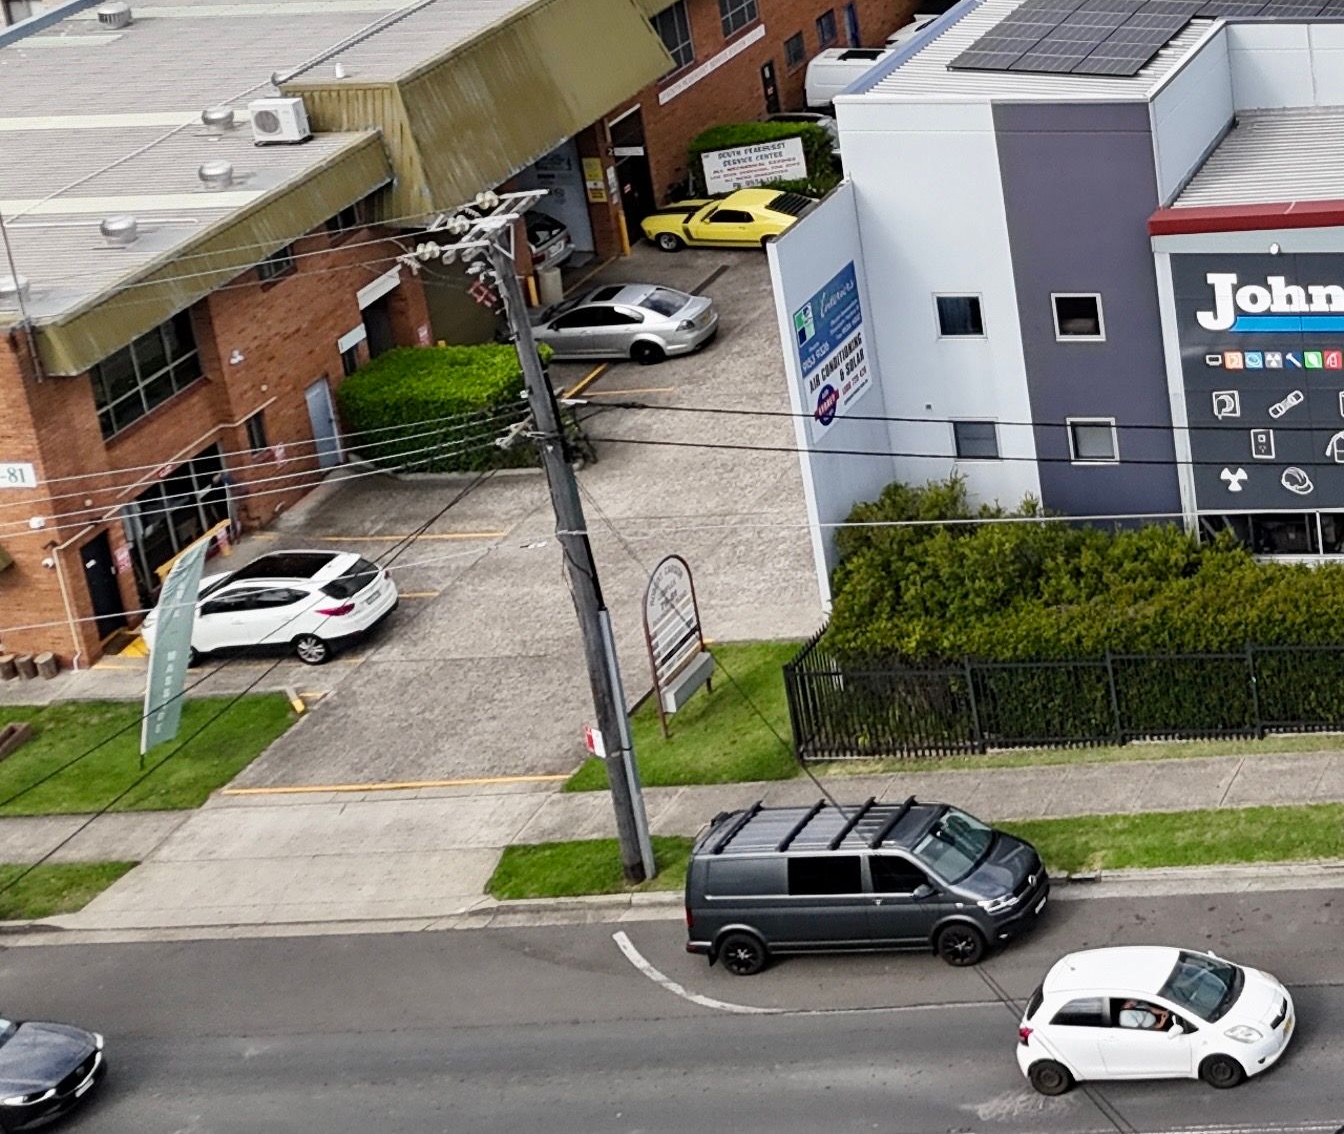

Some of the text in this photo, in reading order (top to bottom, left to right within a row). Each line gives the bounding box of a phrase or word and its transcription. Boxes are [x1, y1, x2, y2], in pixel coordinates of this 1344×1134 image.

[718, 150, 742, 159] SOUTH
[723, 151, 784, 168] SERVICE CENTRE
[809, 373, 821, 394] AIR
[821, 332, 863, 380] CONDITIONING
[845, 348, 865, 377] SOLAR
